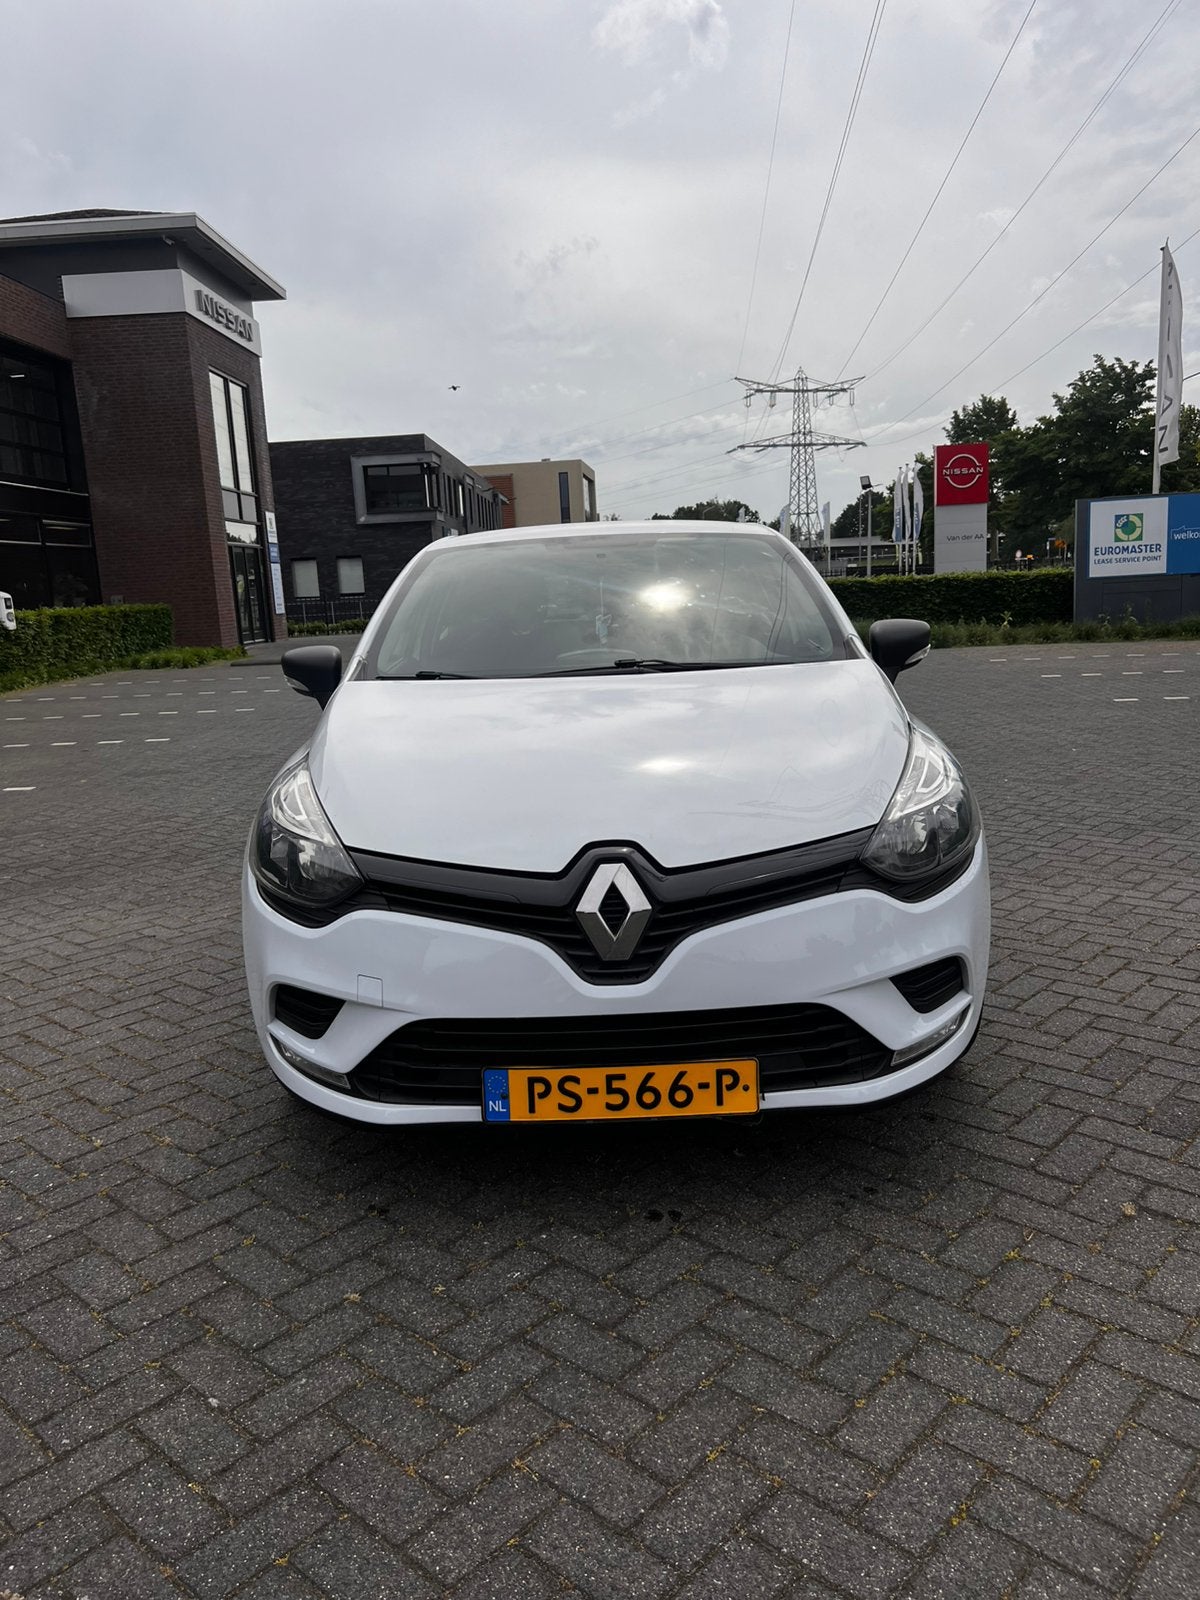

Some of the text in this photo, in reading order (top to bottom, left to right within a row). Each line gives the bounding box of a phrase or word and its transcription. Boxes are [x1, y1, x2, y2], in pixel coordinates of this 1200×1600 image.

[194, 290, 253, 342] NISSAN
[942, 467, 984, 476] NISSAN
[1174, 530, 1200, 540] welko
[1094, 543, 1162, 556] EUROMASTER
[527, 1068, 740, 1114] PS-566-P
[489, 1100, 507, 1112] NL
